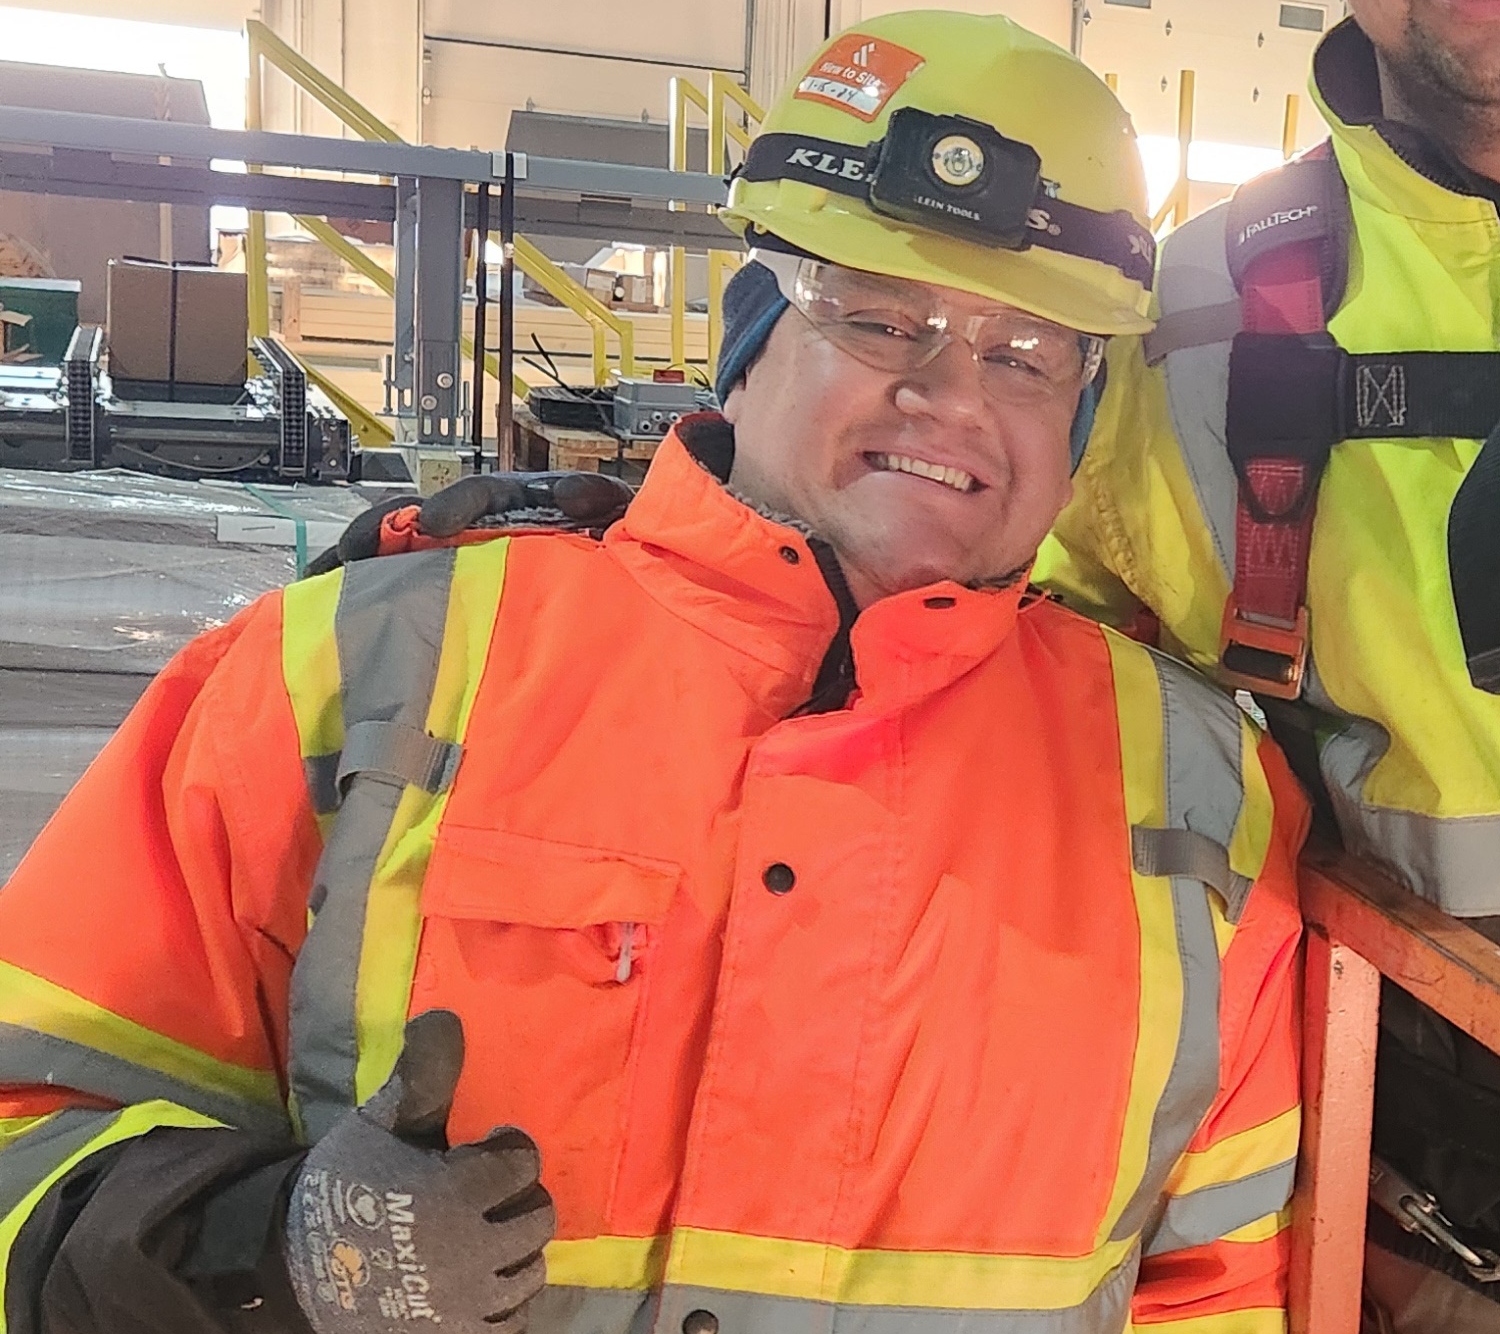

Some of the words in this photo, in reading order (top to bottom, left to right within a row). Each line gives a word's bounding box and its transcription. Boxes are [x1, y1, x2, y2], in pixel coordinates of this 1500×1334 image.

[842, 67, 856, 79] to
[946, 203, 981, 221] TOOLS
[386, 1190, 437, 1321] MaxiCut
